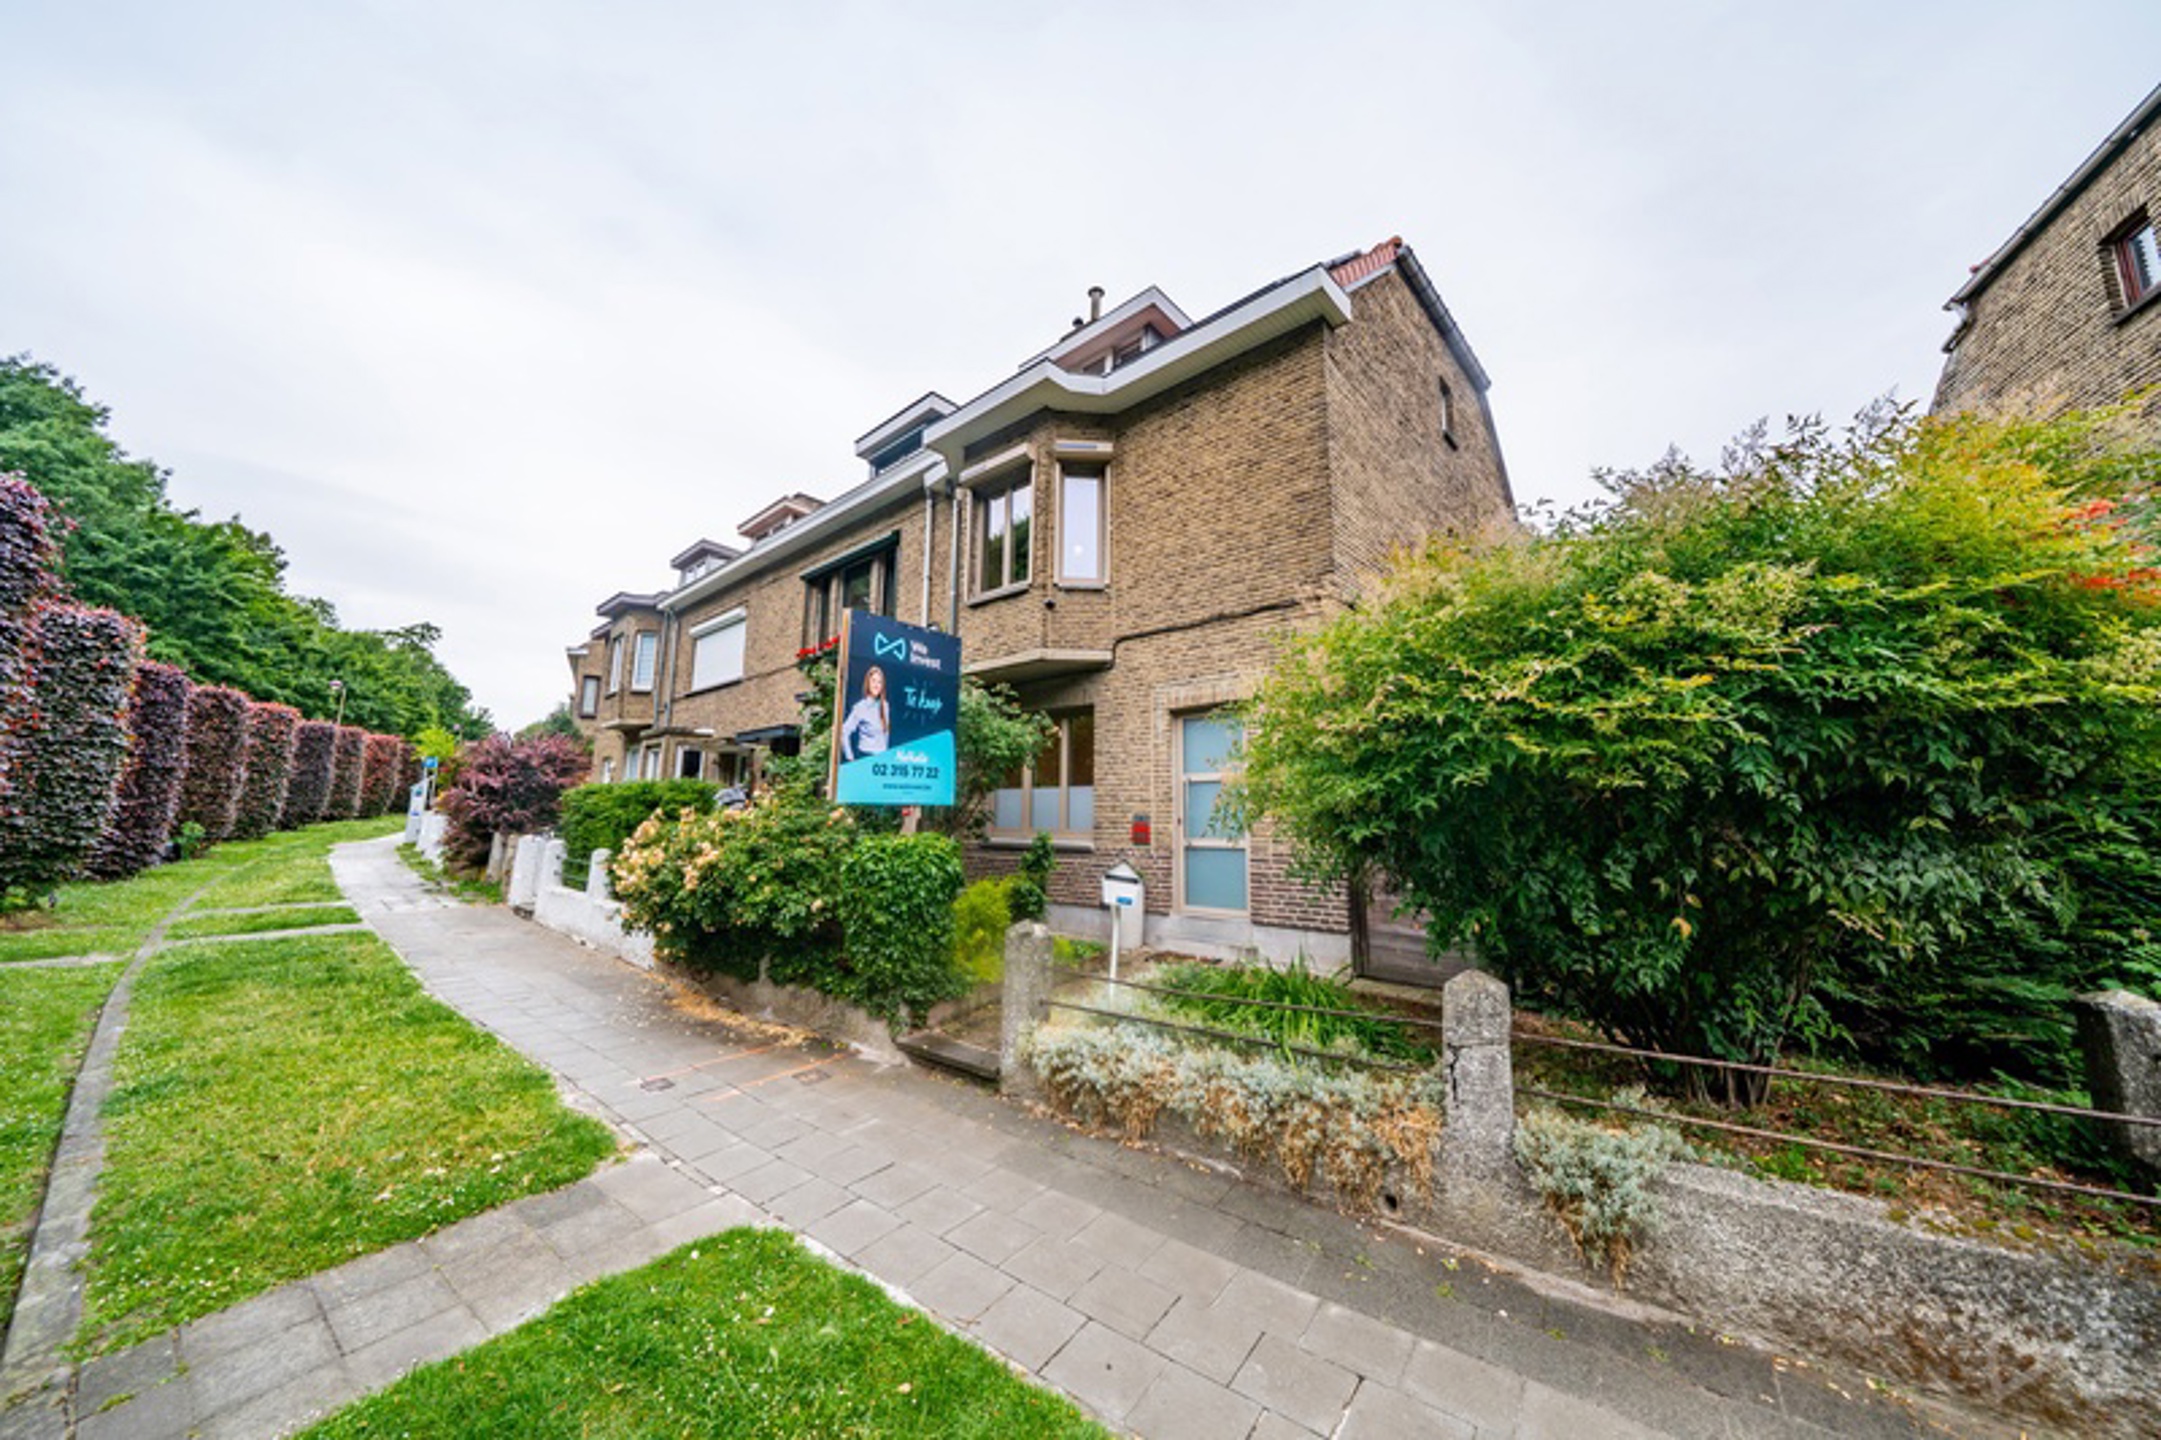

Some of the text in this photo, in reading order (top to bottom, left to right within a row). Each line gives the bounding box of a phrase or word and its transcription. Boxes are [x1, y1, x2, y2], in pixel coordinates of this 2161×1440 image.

[872, 763, 887, 776] 02
[912, 765, 925, 779] 77
[926, 766, 940, 779] 22
